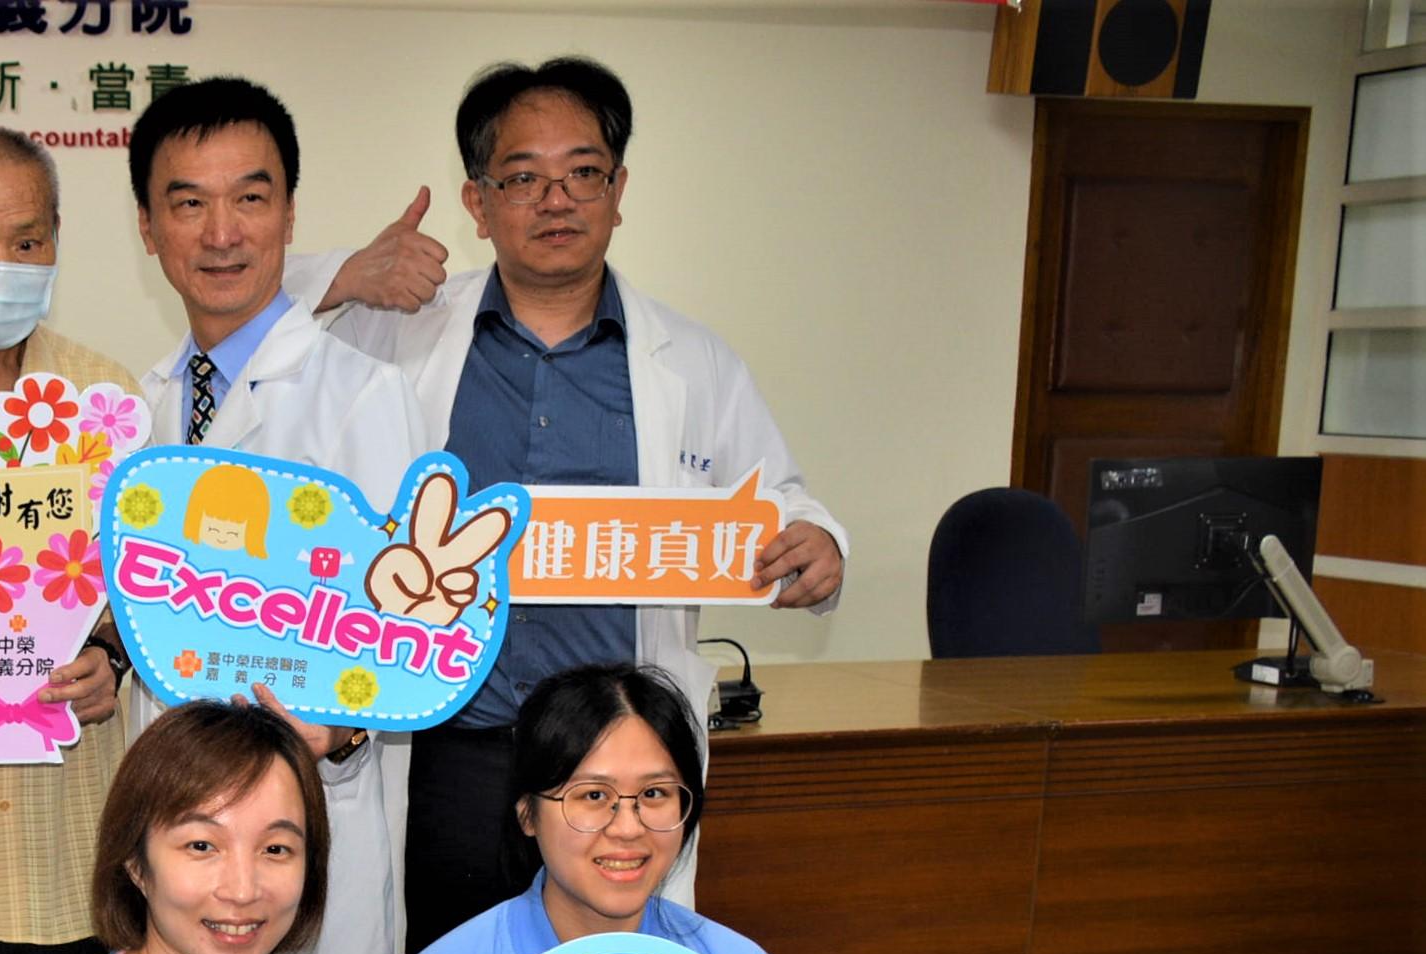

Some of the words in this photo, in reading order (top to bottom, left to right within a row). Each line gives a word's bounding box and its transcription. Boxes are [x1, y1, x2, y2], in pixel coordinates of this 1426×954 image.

[522, 520, 764, 582] 健康真好
[116, 539, 482, 681] Excellent
[208, 651, 308, 673] 臺中榮民總醫院
